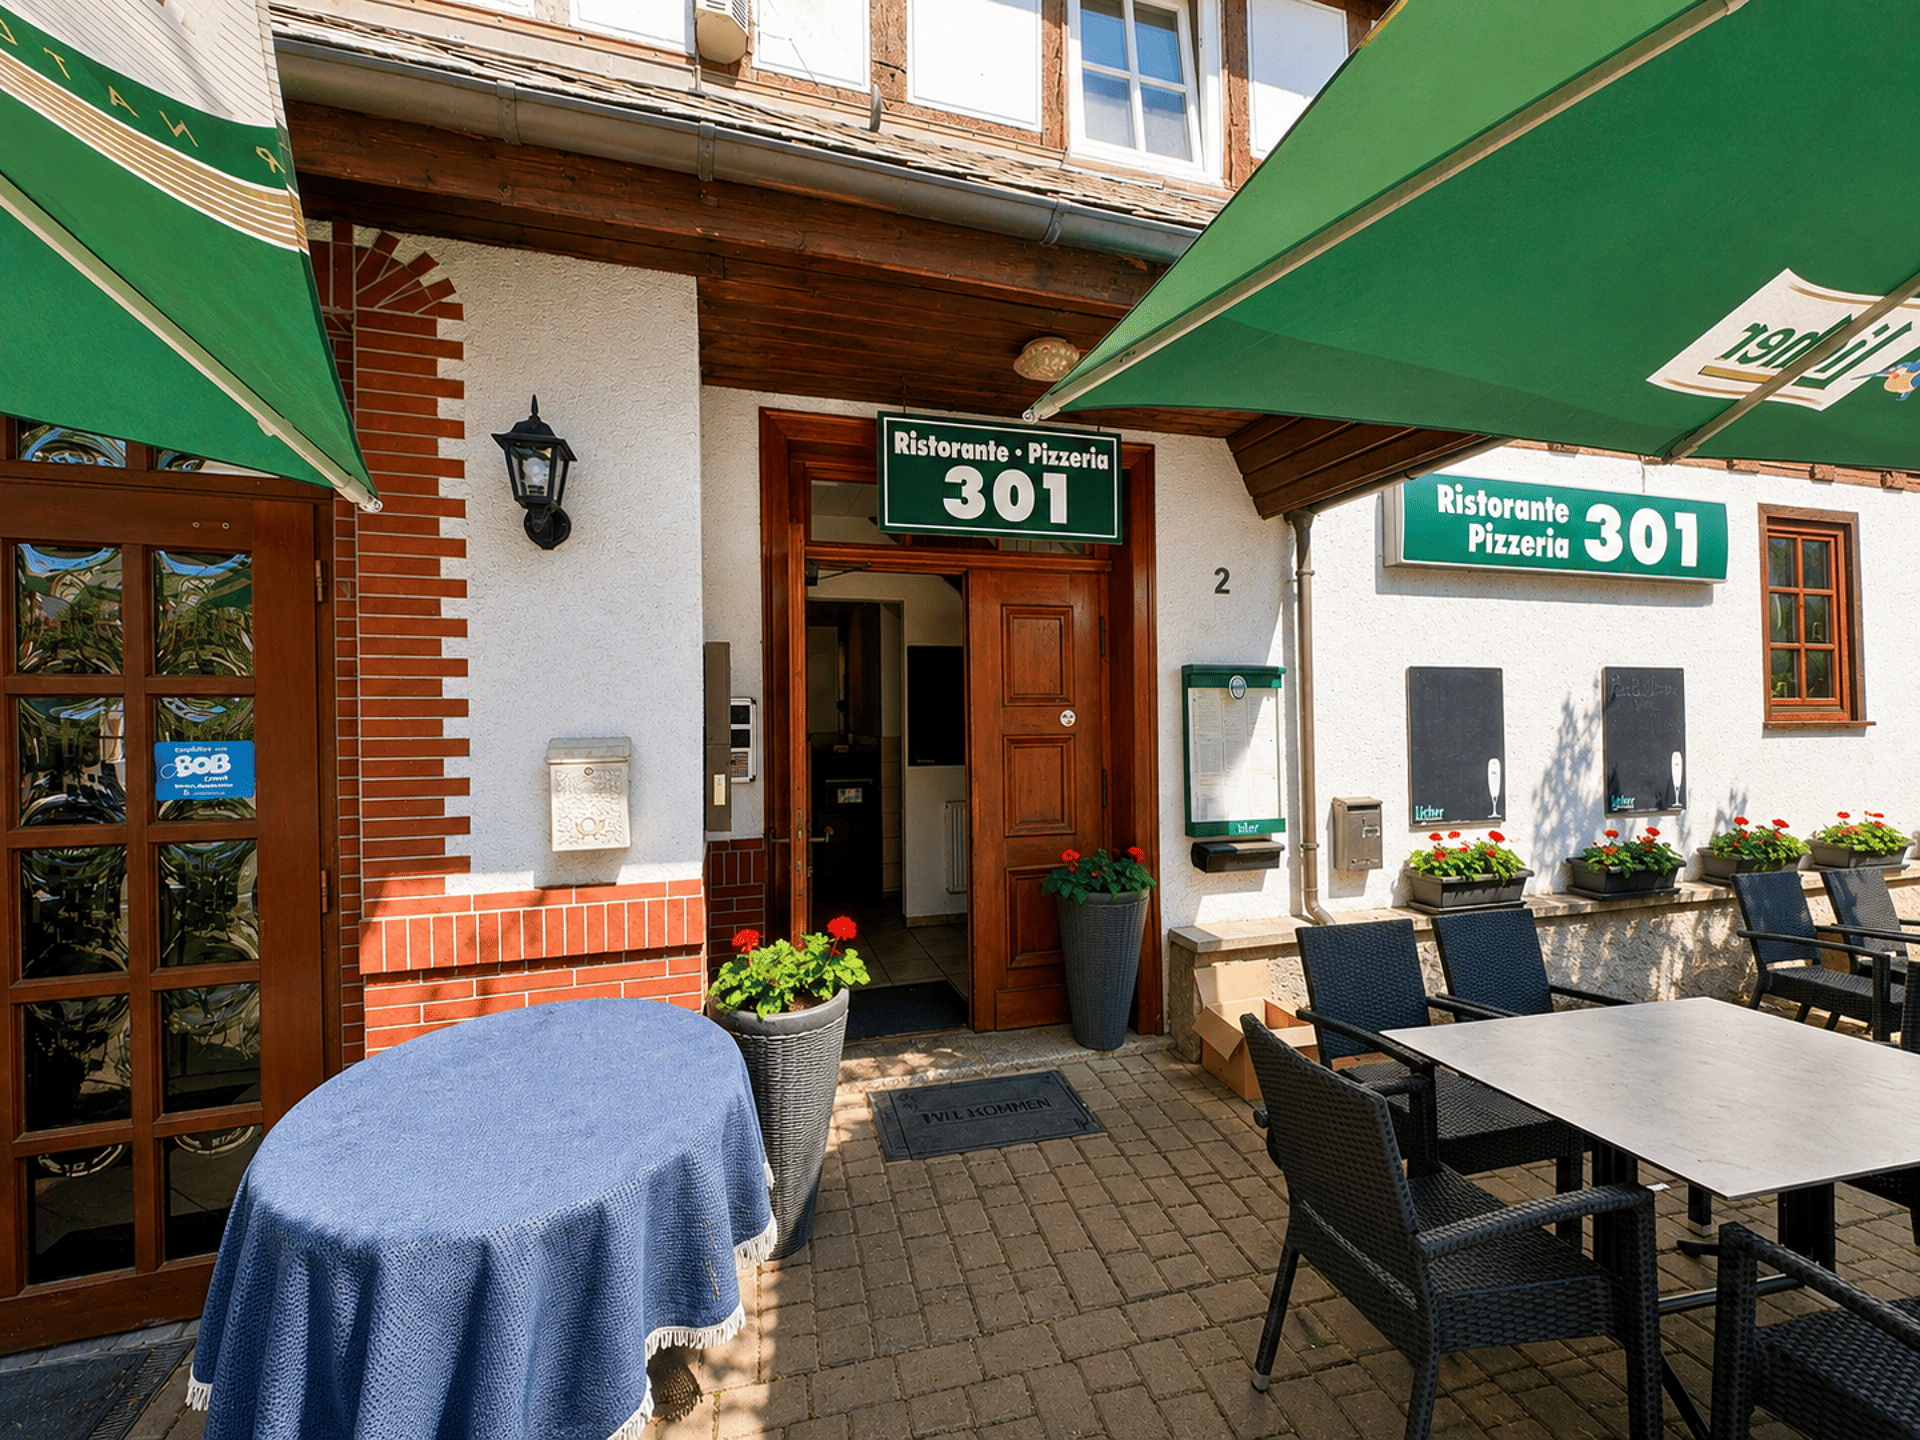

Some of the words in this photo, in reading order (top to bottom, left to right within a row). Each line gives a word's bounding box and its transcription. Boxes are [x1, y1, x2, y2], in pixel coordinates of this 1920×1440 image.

[894, 430, 1009, 463] Ristorante
[1028, 442, 1109, 470] Pizzeria
[943, 465, 1068, 525] 301
[1437, 484, 1569, 523] Ristorante
[1468, 522, 1569, 559] Pizzeria
[1584, 503, 1698, 568] 301
[1214, 566, 1230, 594] 2
[174, 753, 232, 778] BOB
